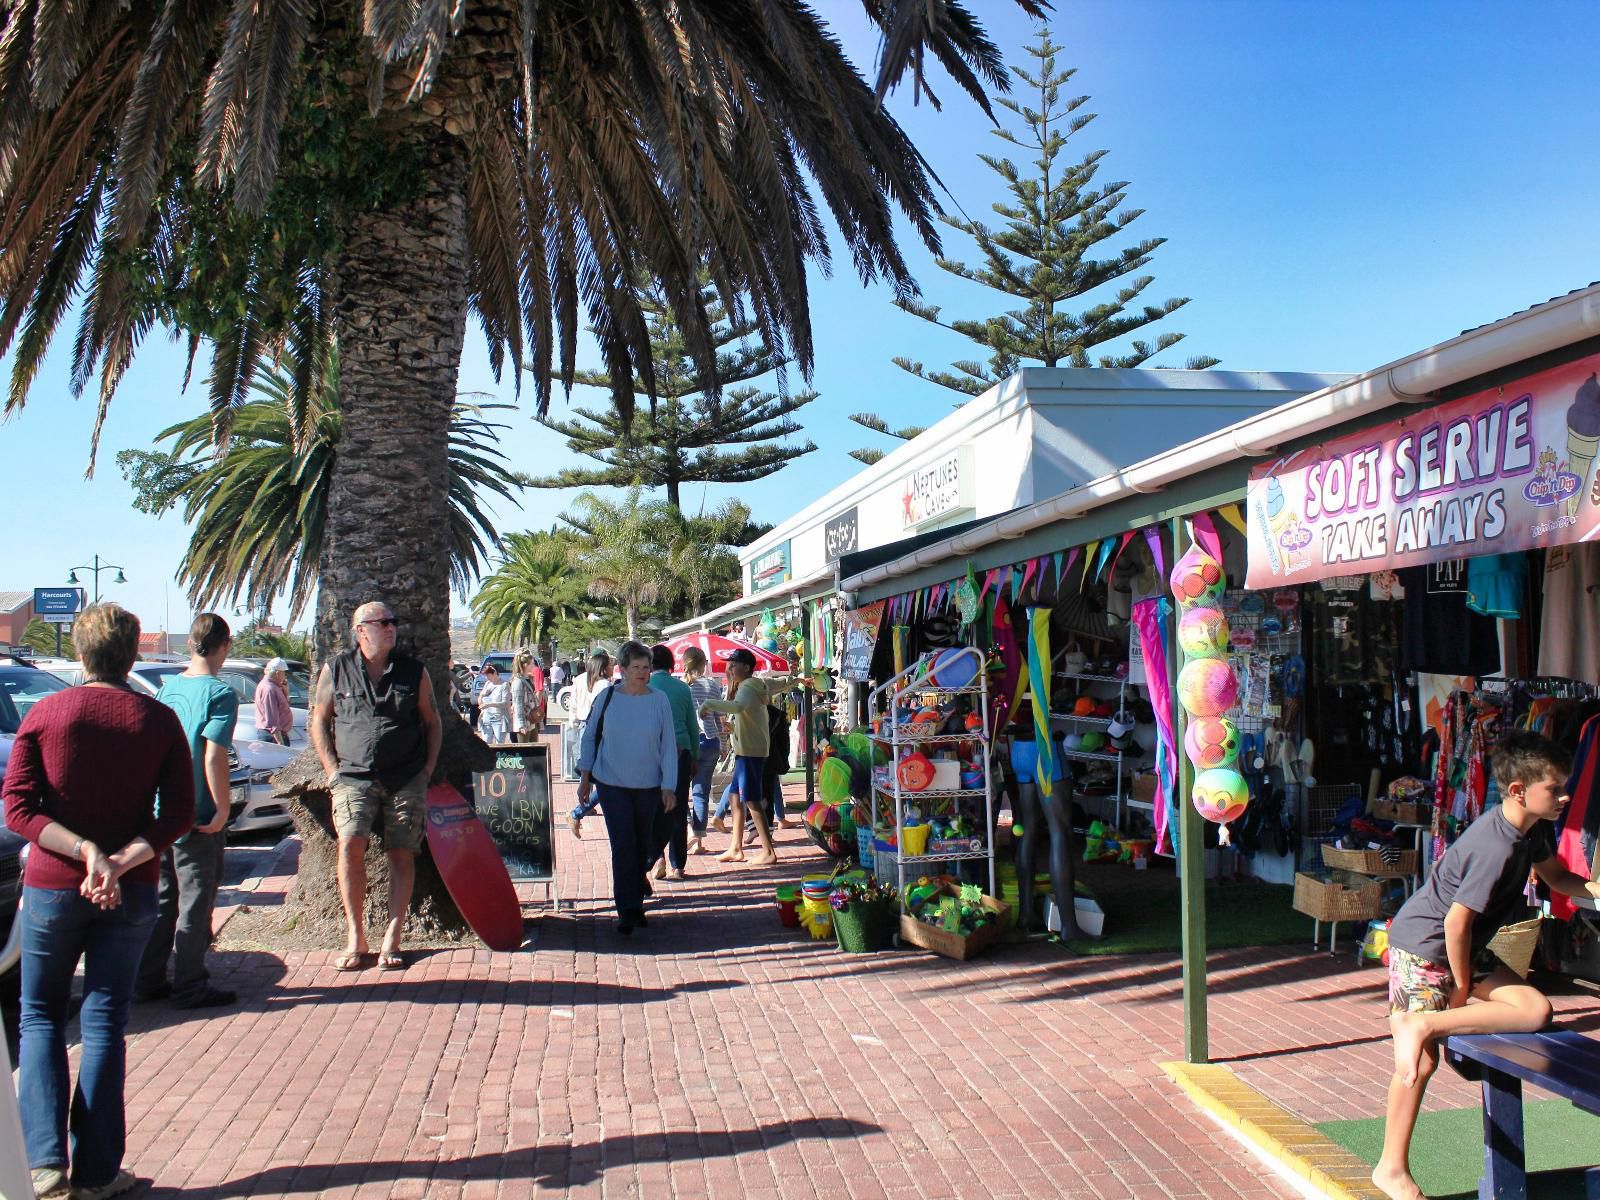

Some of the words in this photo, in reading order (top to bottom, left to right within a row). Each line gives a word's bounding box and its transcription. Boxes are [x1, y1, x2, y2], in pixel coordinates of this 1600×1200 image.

[1305, 442, 1382, 522] SOFT
[1392, 394, 1535, 503] SERVE
[1321, 514, 1386, 565] TAKE
[1395, 488, 1507, 555] AWAYS
[480, 772, 506, 798] 10
[475, 804, 499, 816] ave
[511, 799, 543, 821] LBN
[489, 818, 533, 834] GOON
[492, 834, 540, 845] orters
